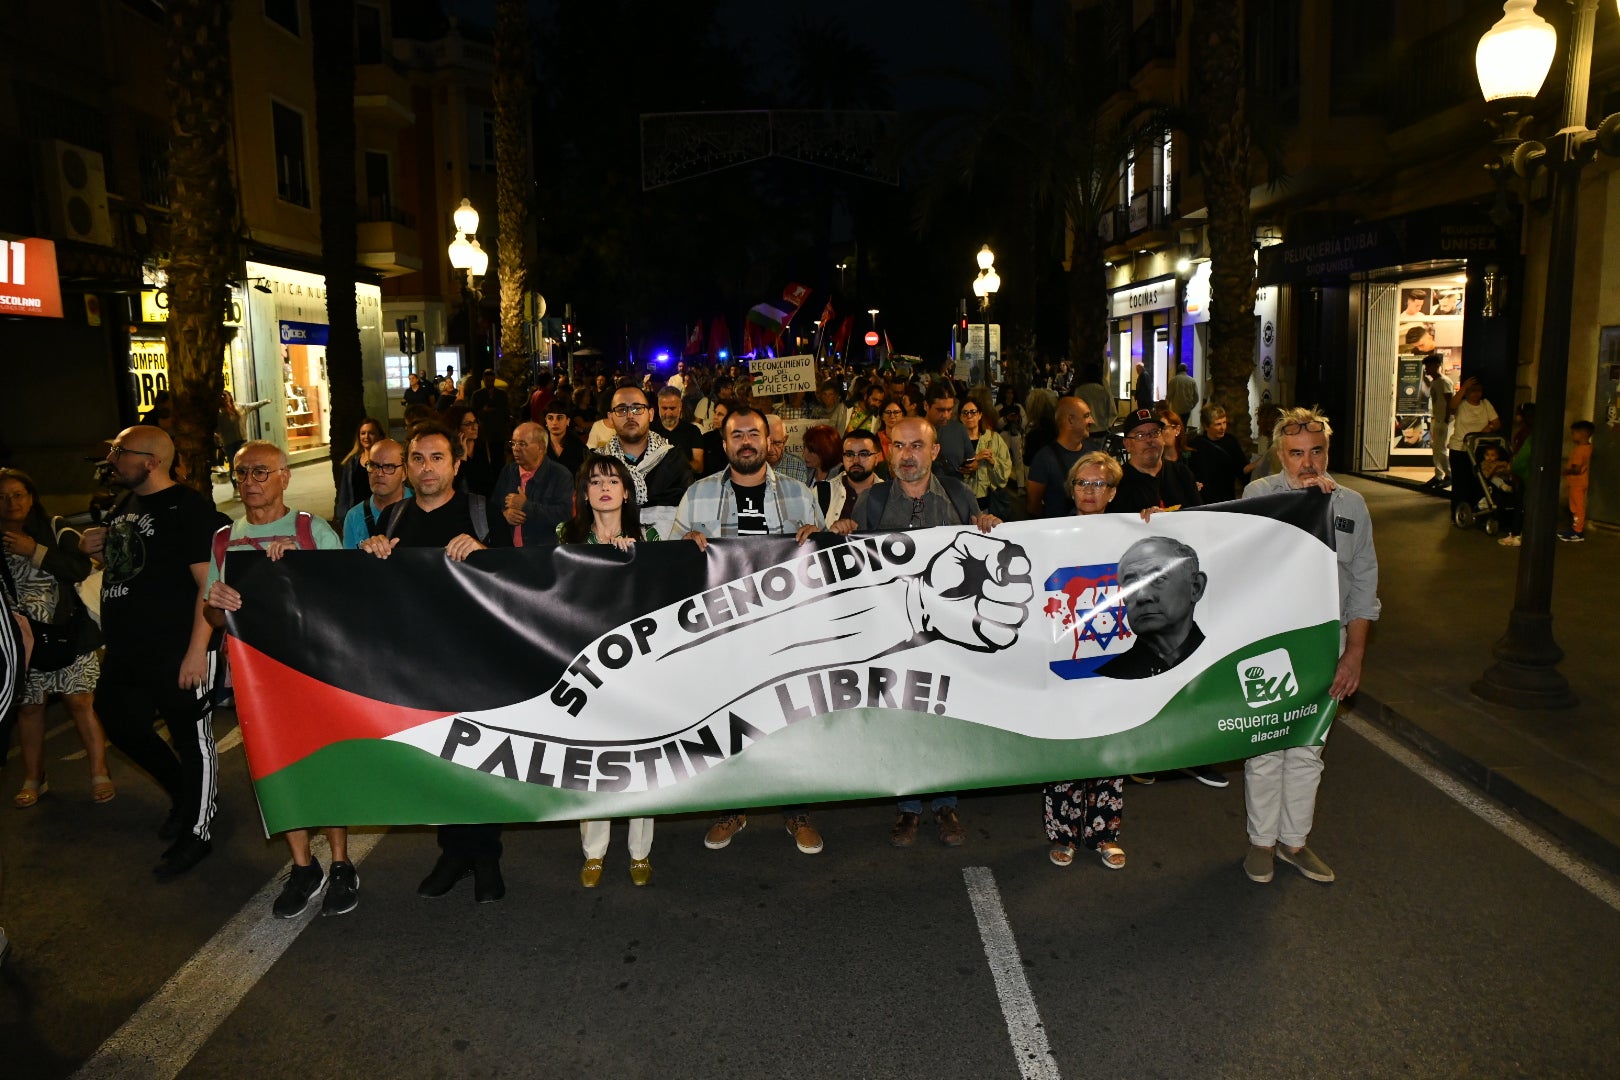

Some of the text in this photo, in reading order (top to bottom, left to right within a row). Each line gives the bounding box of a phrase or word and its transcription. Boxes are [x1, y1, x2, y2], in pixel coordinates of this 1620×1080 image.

[1344, 231, 1378, 253] DUBAI
[1441, 238, 1497, 250] UNISEX
[1306, 257, 1355, 277] SHOP UNISEX
[0, 294, 41, 308] SCOLANO
[1129, 290, 1158, 308] COCINAS
[281, 324, 307, 341] WIDEX
[132, 353, 165, 370] OMPRO
[762, 374, 801, 384] PUEBLO
[757, 382, 811, 394] PALESTINO
[138, 513, 155, 537] like
[549, 532, 916, 718] STOP GENOCIDIO
[1218, 703, 1318, 732] esquerra unida
[439, 666, 951, 793] PALESTINA LIBRE!
[1251, 726, 1290, 743] alacant
